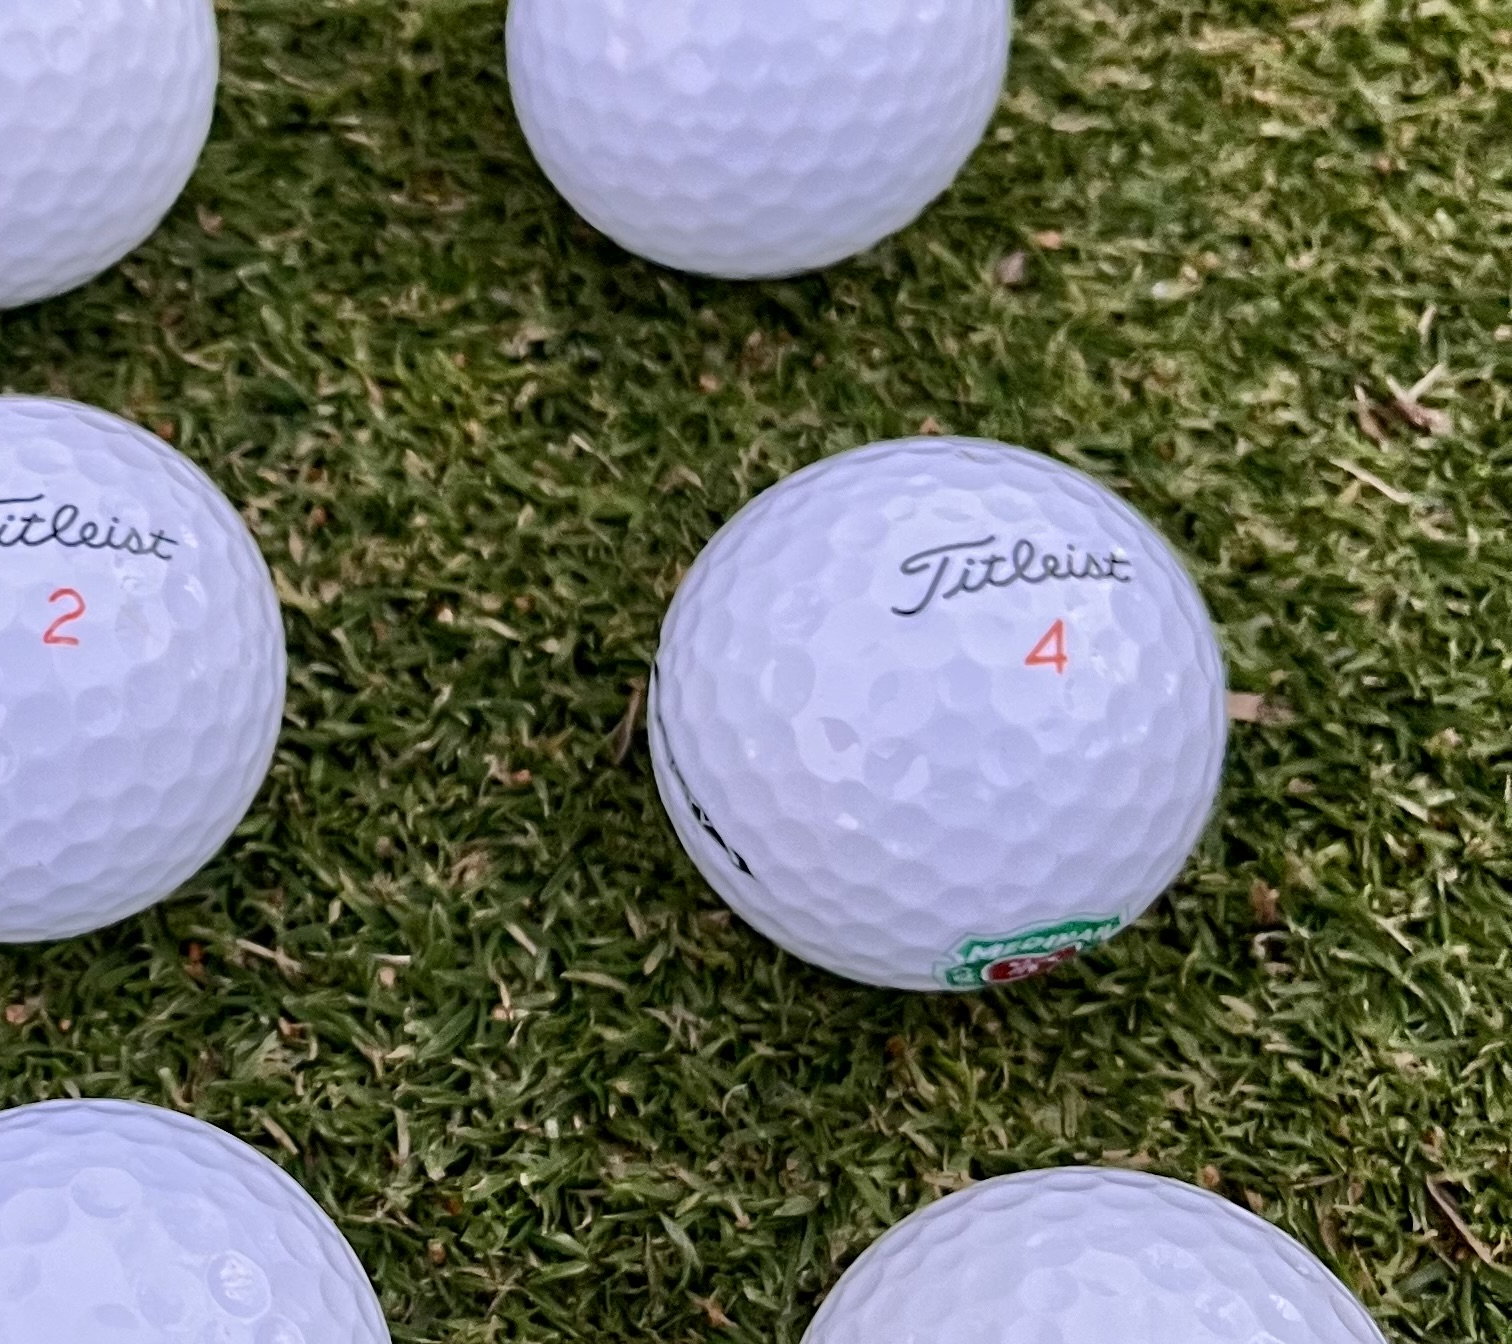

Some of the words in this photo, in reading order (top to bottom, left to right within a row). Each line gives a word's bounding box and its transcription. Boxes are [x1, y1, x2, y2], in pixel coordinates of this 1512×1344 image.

[890, 534, 1134, 617] Titleist
[42, 587, 88, 646] 2
[1024, 618, 1069, 675] 4
